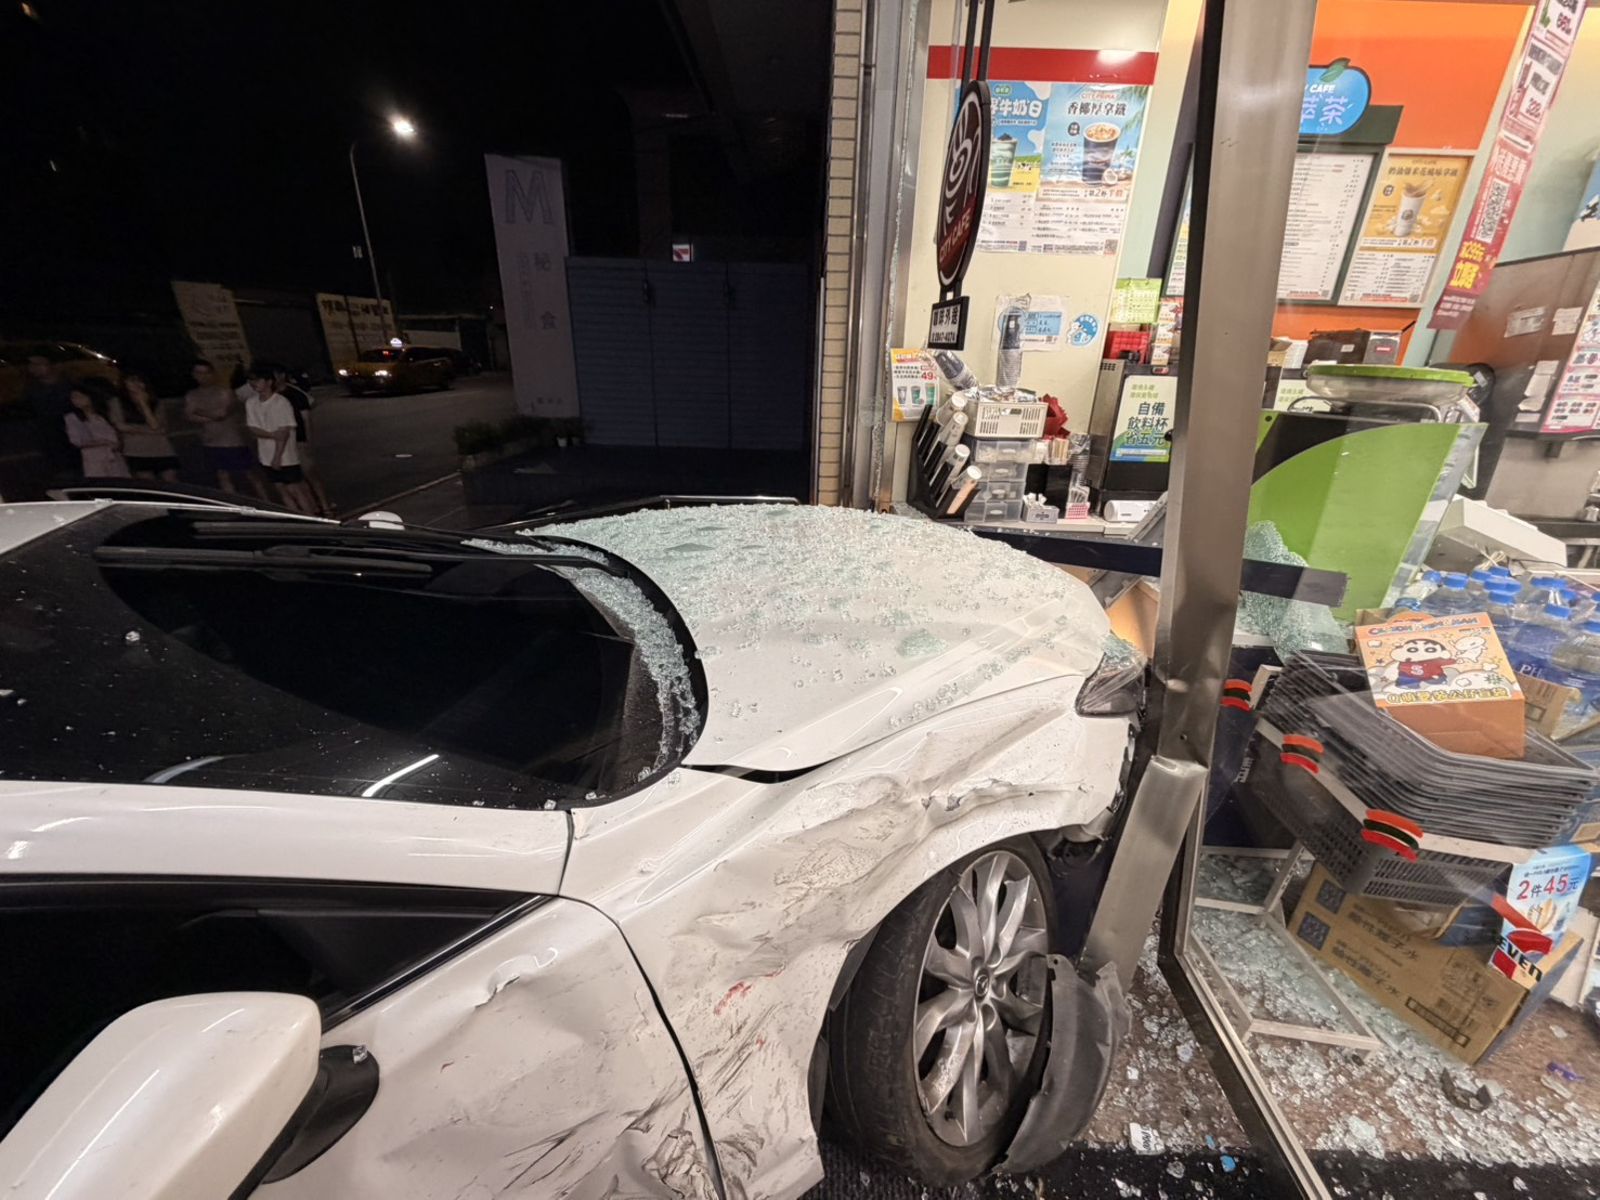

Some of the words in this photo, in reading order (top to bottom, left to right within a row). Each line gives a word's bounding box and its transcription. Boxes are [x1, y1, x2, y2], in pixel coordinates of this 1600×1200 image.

[1309, 84, 1336, 93] CAFE
[951, 207, 972, 247] CAFE
[1138, 402, 1166, 416] 自備
[1127, 416, 1169, 431] 飲料杯
[1125, 431, 1165, 446] 省五元
[1516, 874, 1578, 900] 2件45元
